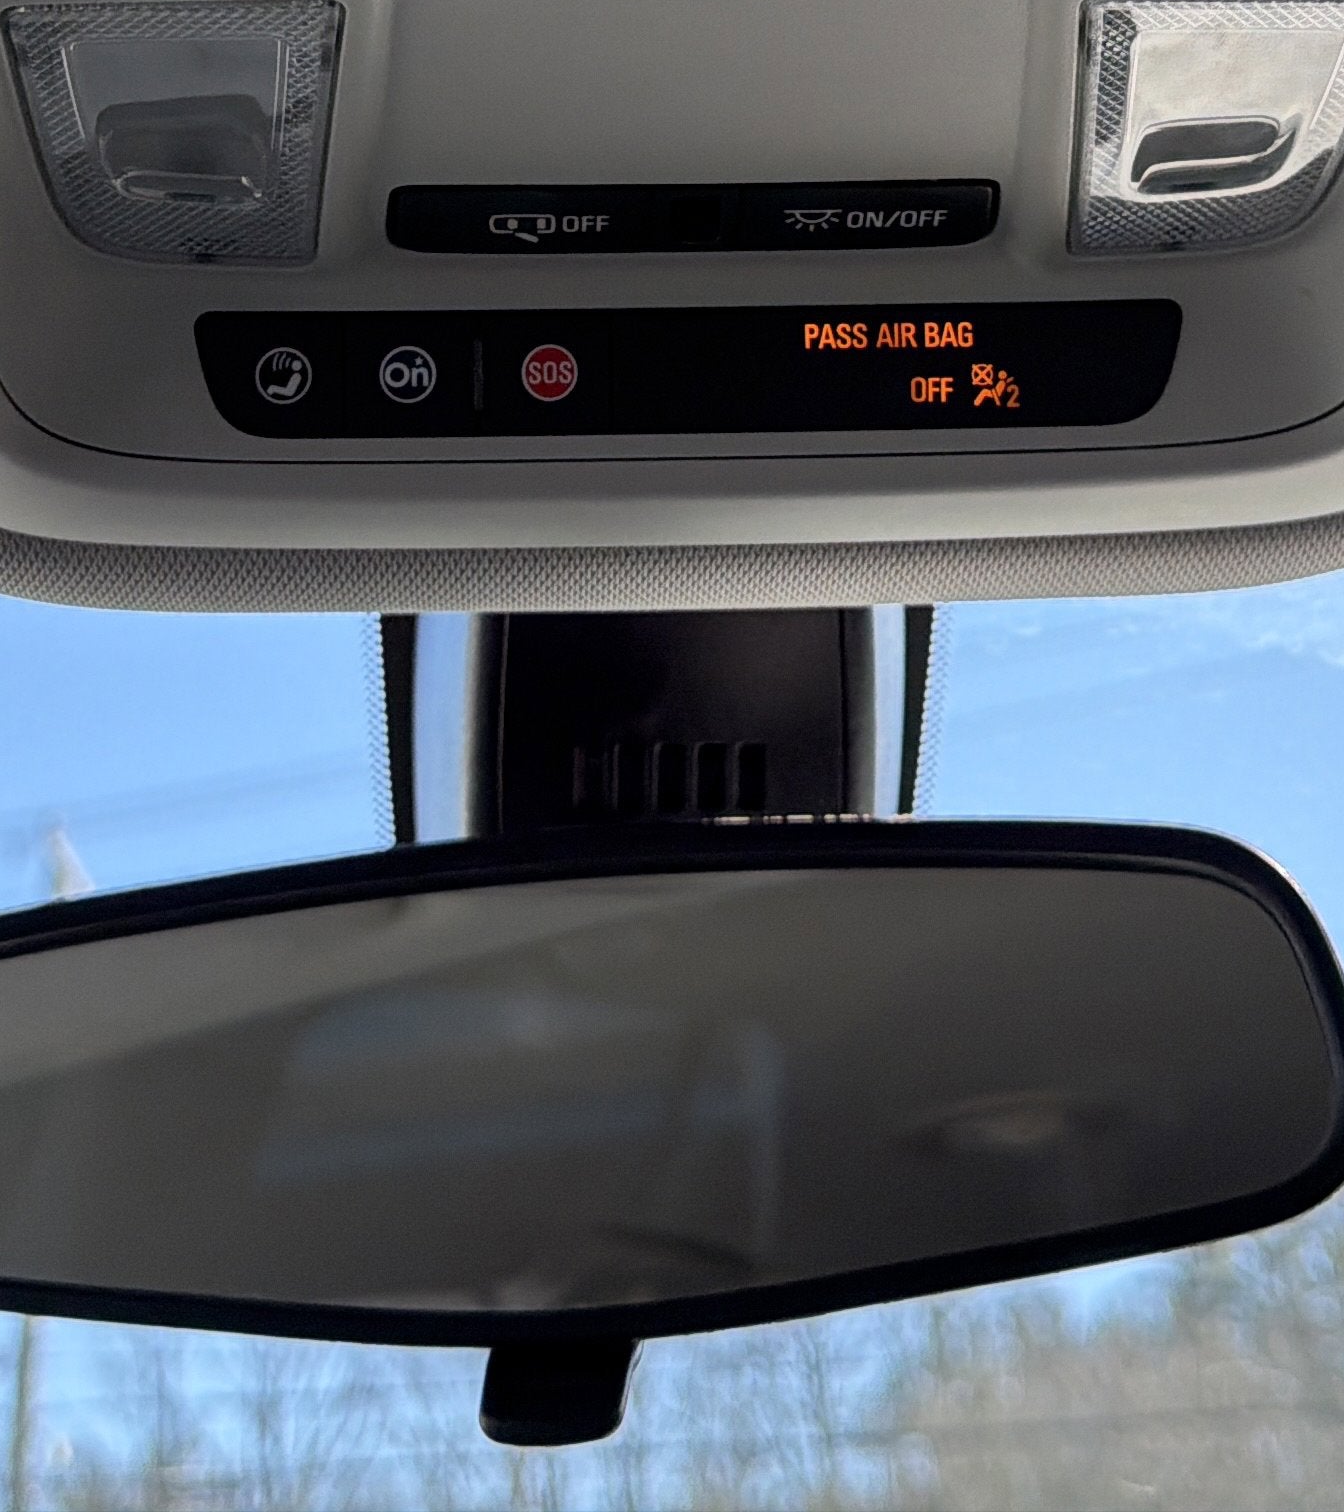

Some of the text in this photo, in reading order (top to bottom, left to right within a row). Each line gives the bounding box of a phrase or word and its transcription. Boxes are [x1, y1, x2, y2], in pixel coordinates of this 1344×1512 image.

[561, 214, 611, 233] OFF
[845, 209, 949, 230] ON/OFF
[804, 321, 975, 350] PASS AIR BAG
[384, 359, 430, 389] On
[527, 360, 573, 385] SOS
[910, 376, 1021, 408] OFF 2
